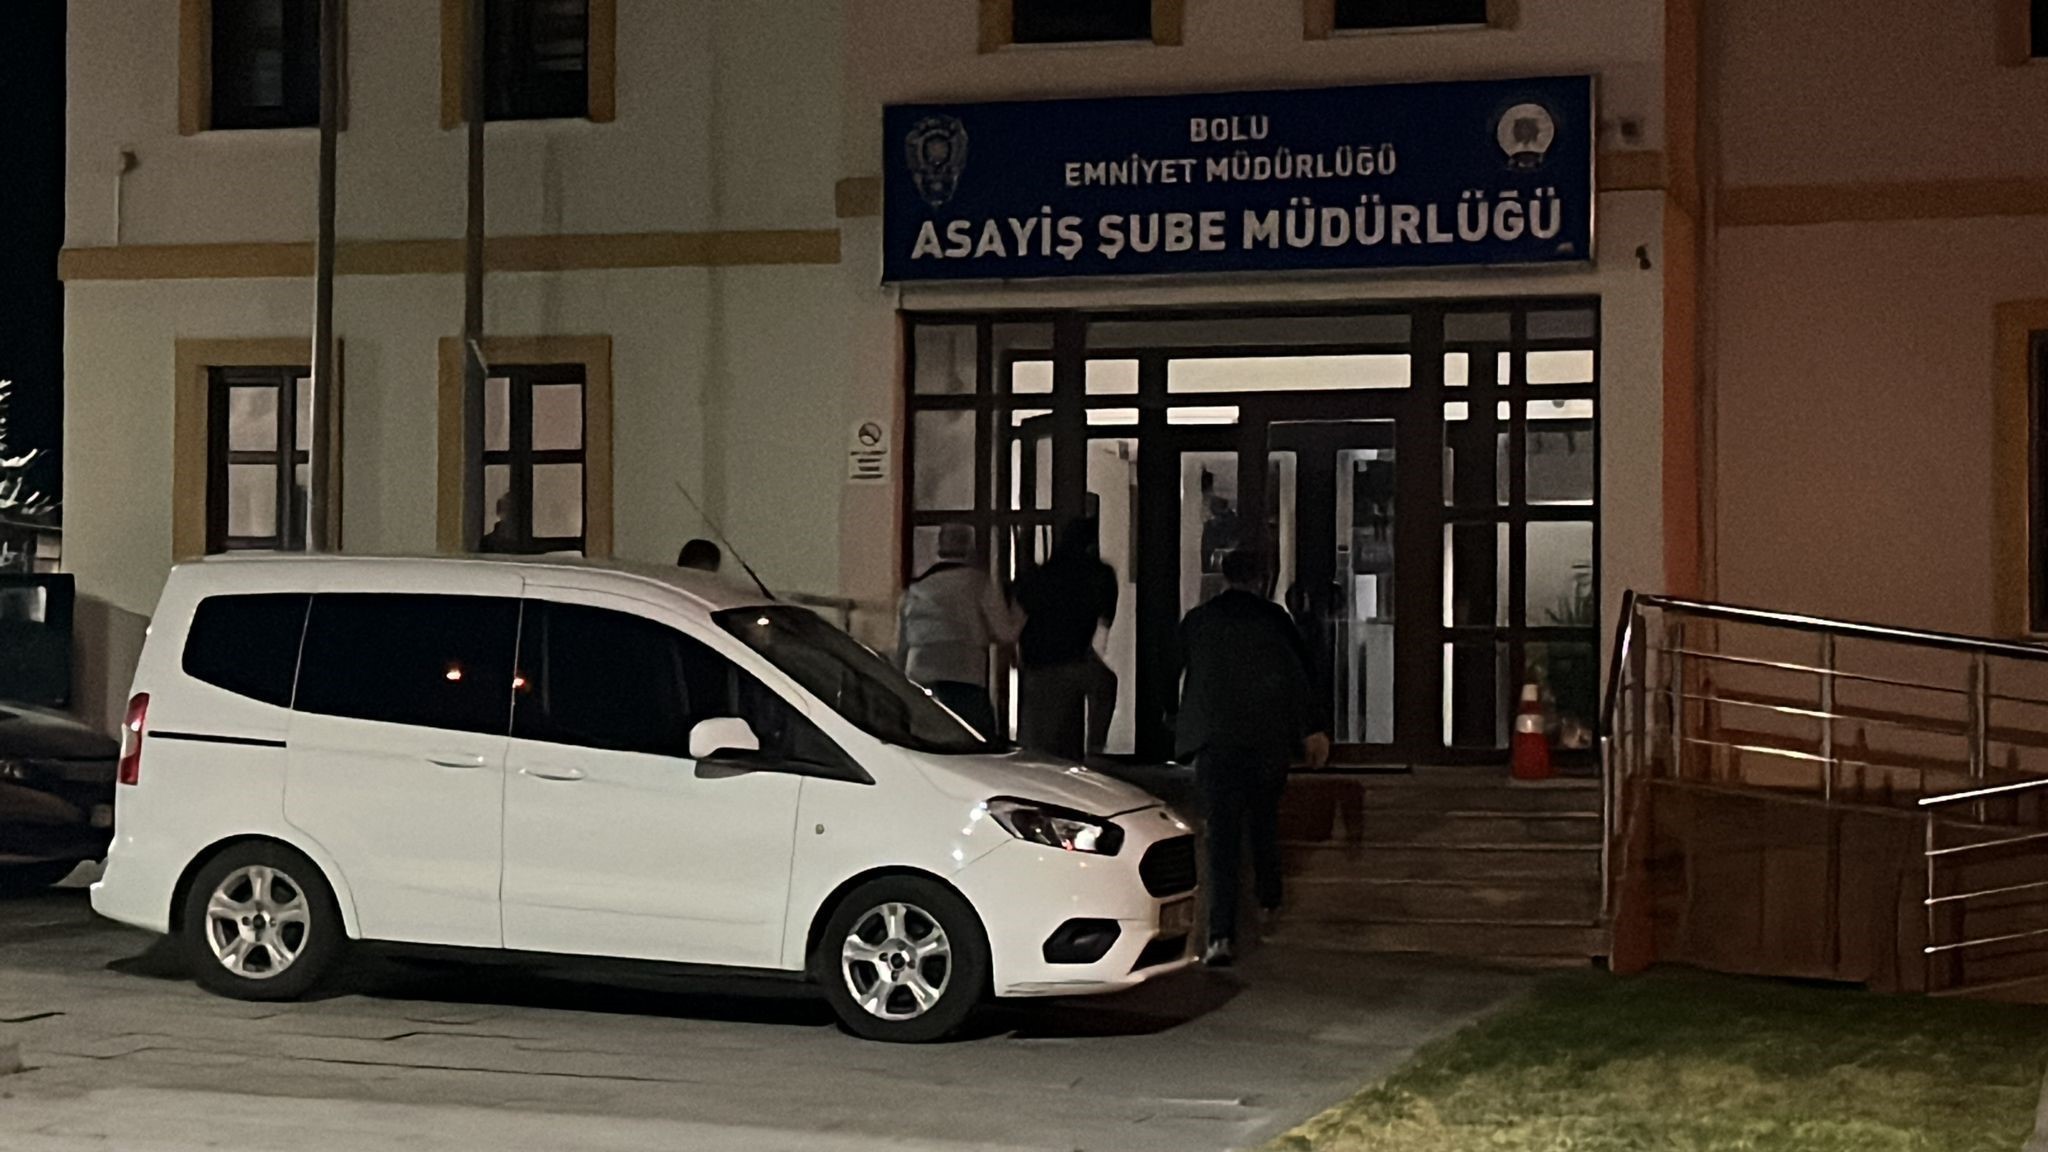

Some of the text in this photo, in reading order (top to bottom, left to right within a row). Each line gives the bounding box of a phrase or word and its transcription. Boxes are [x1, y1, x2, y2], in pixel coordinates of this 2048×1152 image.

[1190, 115, 1268, 142] BOLU
[1065, 143, 1396, 186] EMNİYET MÜDÜRLÜĞÜ
[911, 186, 1561, 261] ASAYİŞ ŞUBE MÜDÜRLÜĞÜ
